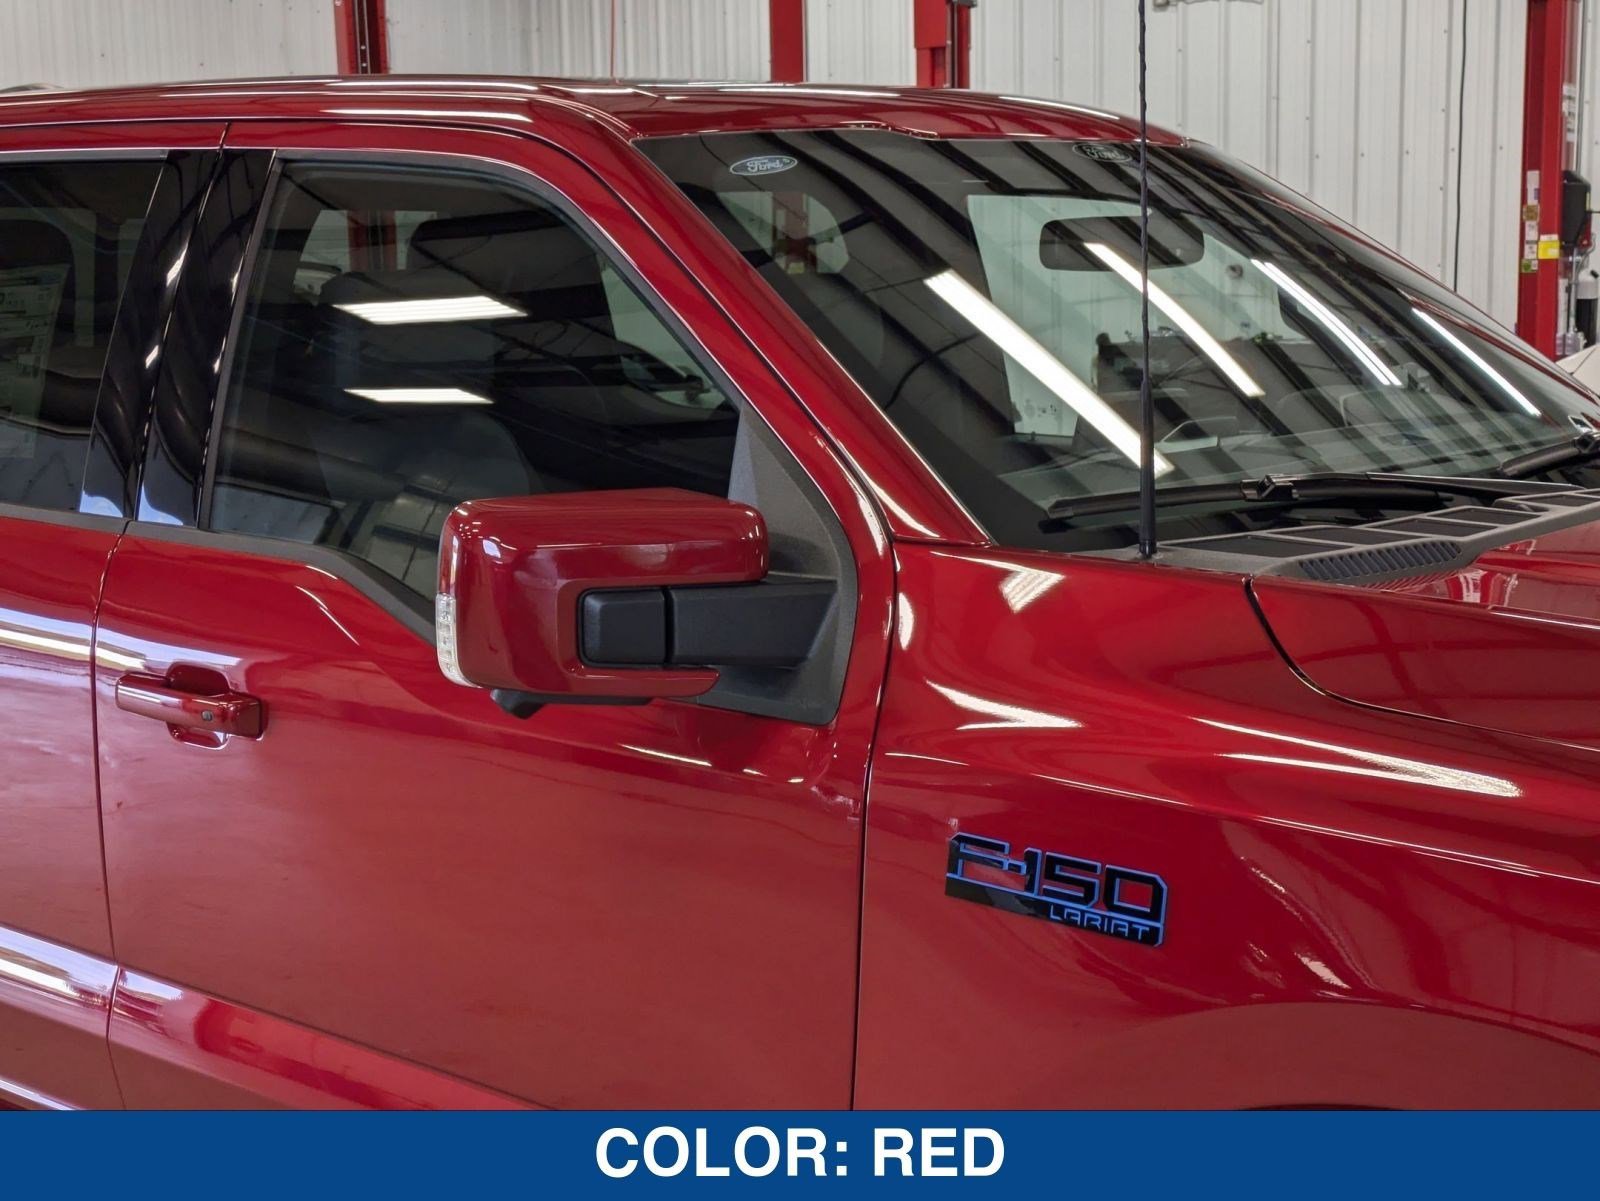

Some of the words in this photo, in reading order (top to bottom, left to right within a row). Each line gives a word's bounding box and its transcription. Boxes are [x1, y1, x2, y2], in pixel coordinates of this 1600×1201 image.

[746, 158, 784, 173] Ford
[946, 832, 1168, 923] F-150
[1049, 904, 1150, 941] LARIAT
